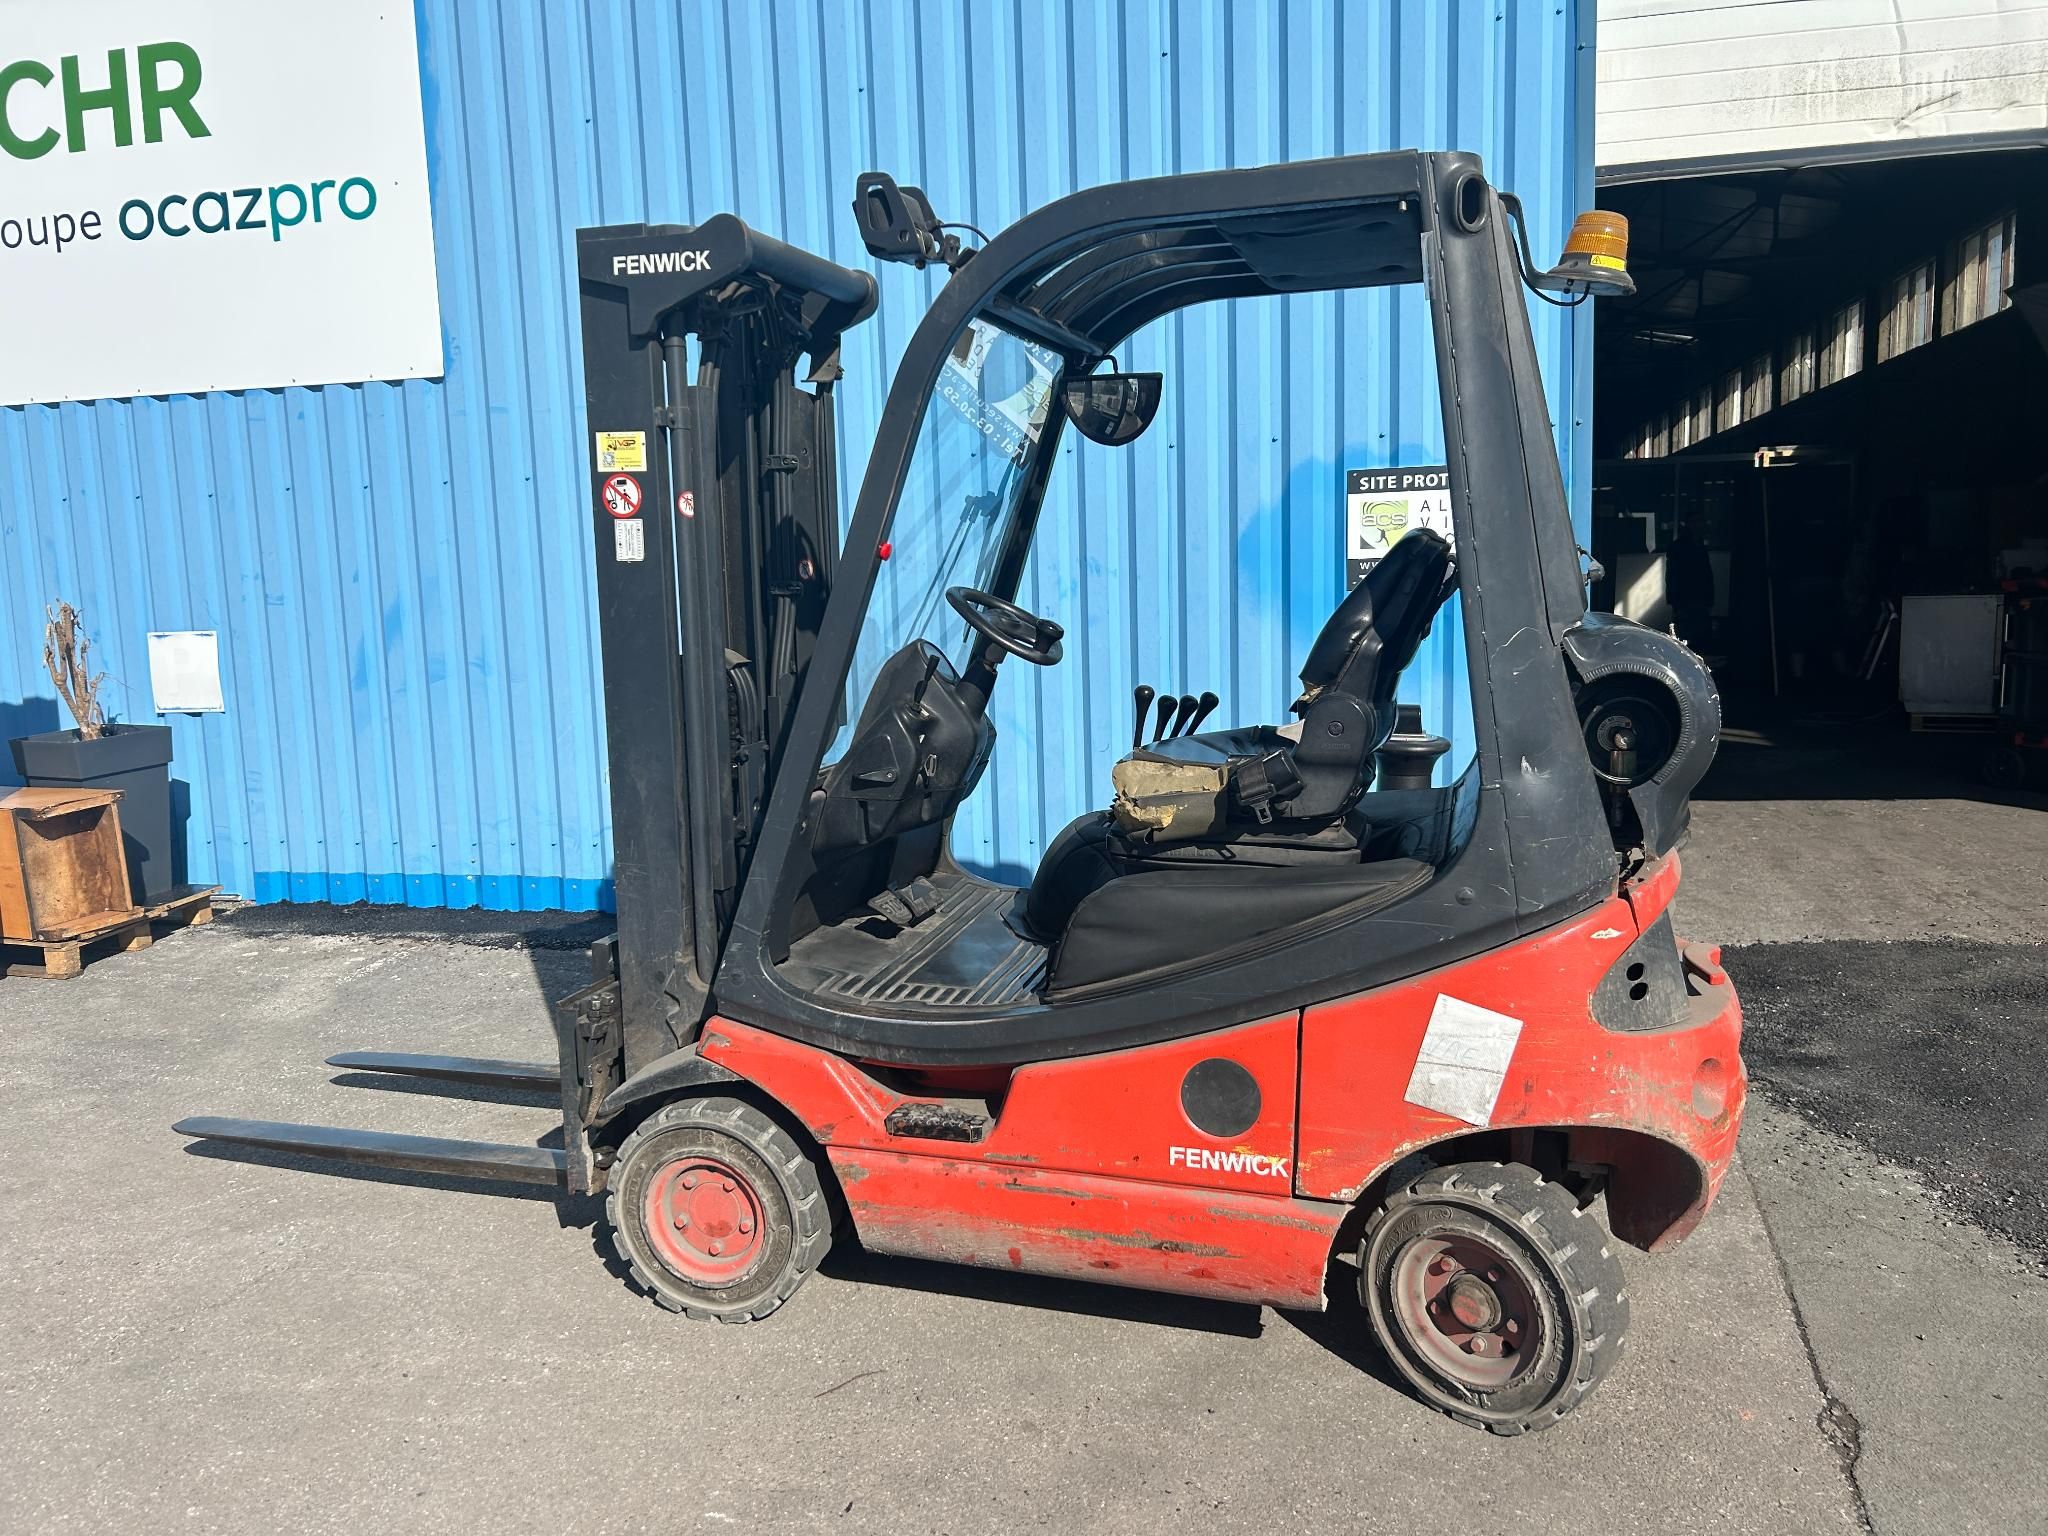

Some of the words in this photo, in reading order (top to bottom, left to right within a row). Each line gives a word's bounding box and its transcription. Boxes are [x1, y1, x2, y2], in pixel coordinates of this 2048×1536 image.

[0, 41, 212, 160] CHR
[1, 211, 102, 253] oupe
[119, 176, 378, 242] ocazpro
[612, 249, 712, 276] FENWICK
[1359, 475, 1397, 490] SITE
[1168, 1145, 1290, 1178] FENWICK
